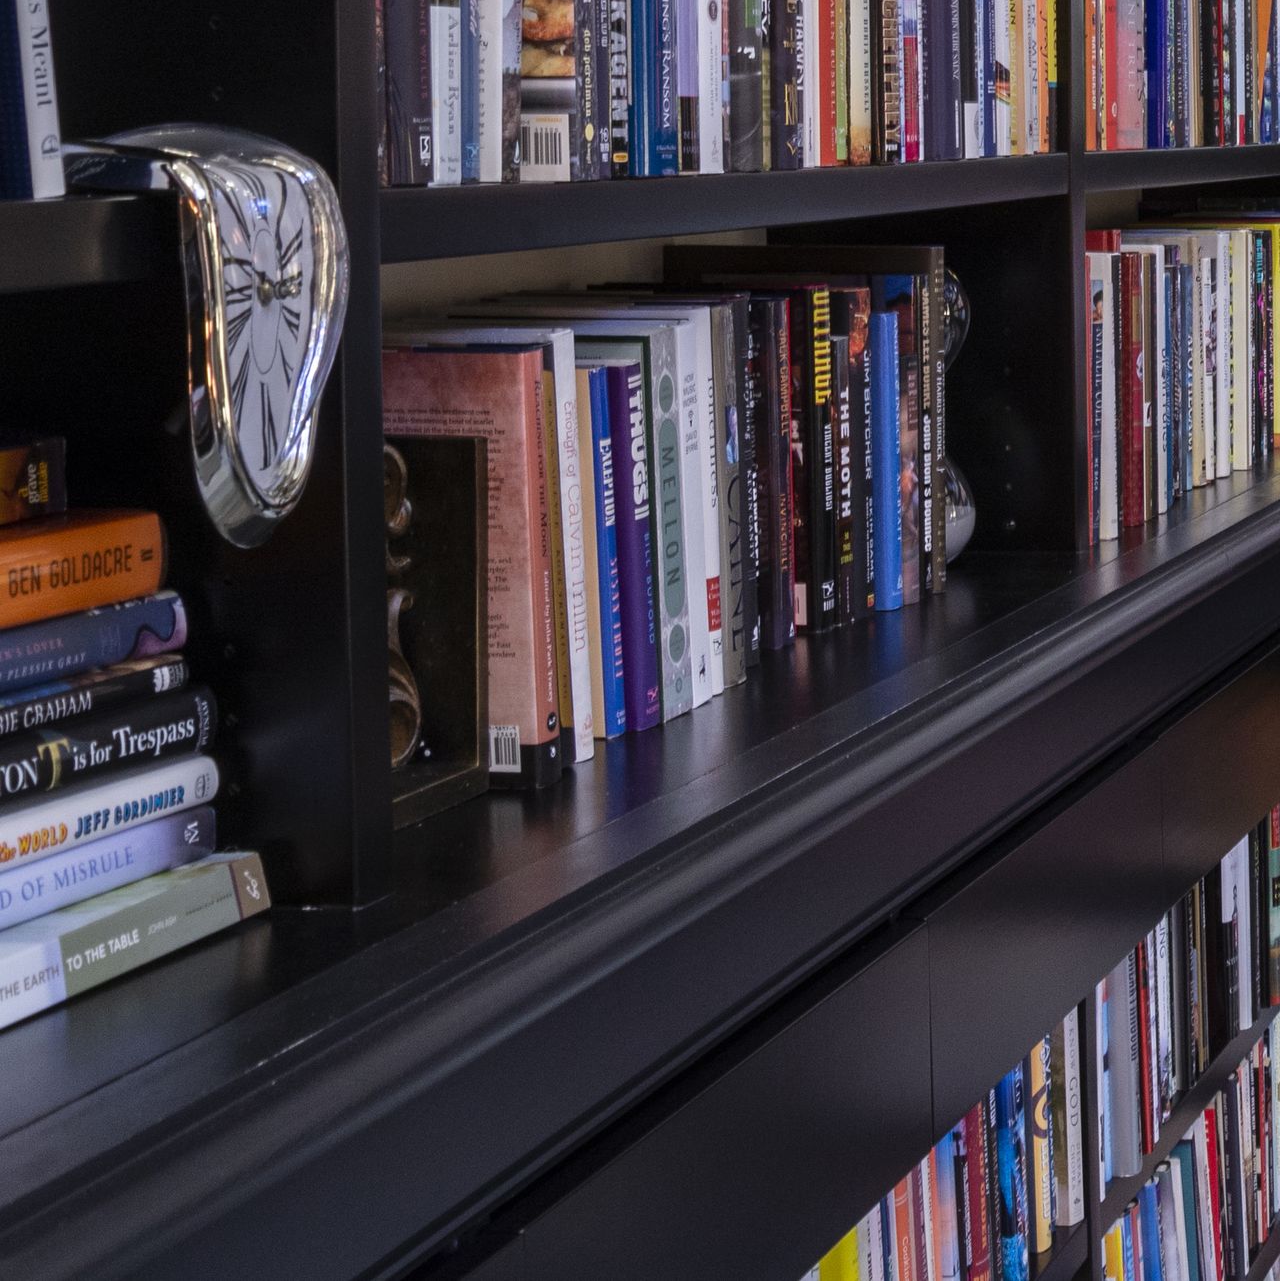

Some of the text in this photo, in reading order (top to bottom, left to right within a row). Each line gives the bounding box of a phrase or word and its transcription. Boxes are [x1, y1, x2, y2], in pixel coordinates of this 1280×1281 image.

[29, 22, 52, 109] Meant
[661, 444, 680, 587] MELLON
[8, 544, 133, 598] BEN GOLDACRE
[23, 691, 93, 730] GRAHAM
[37, 716, 195, 791] T is for Trespass
[19, 785, 185, 861] WORLD JEFF GORDINIER
[20, 848, 134, 900] OF MISRULE
[66, 929, 140, 972] TO THE TABLE
